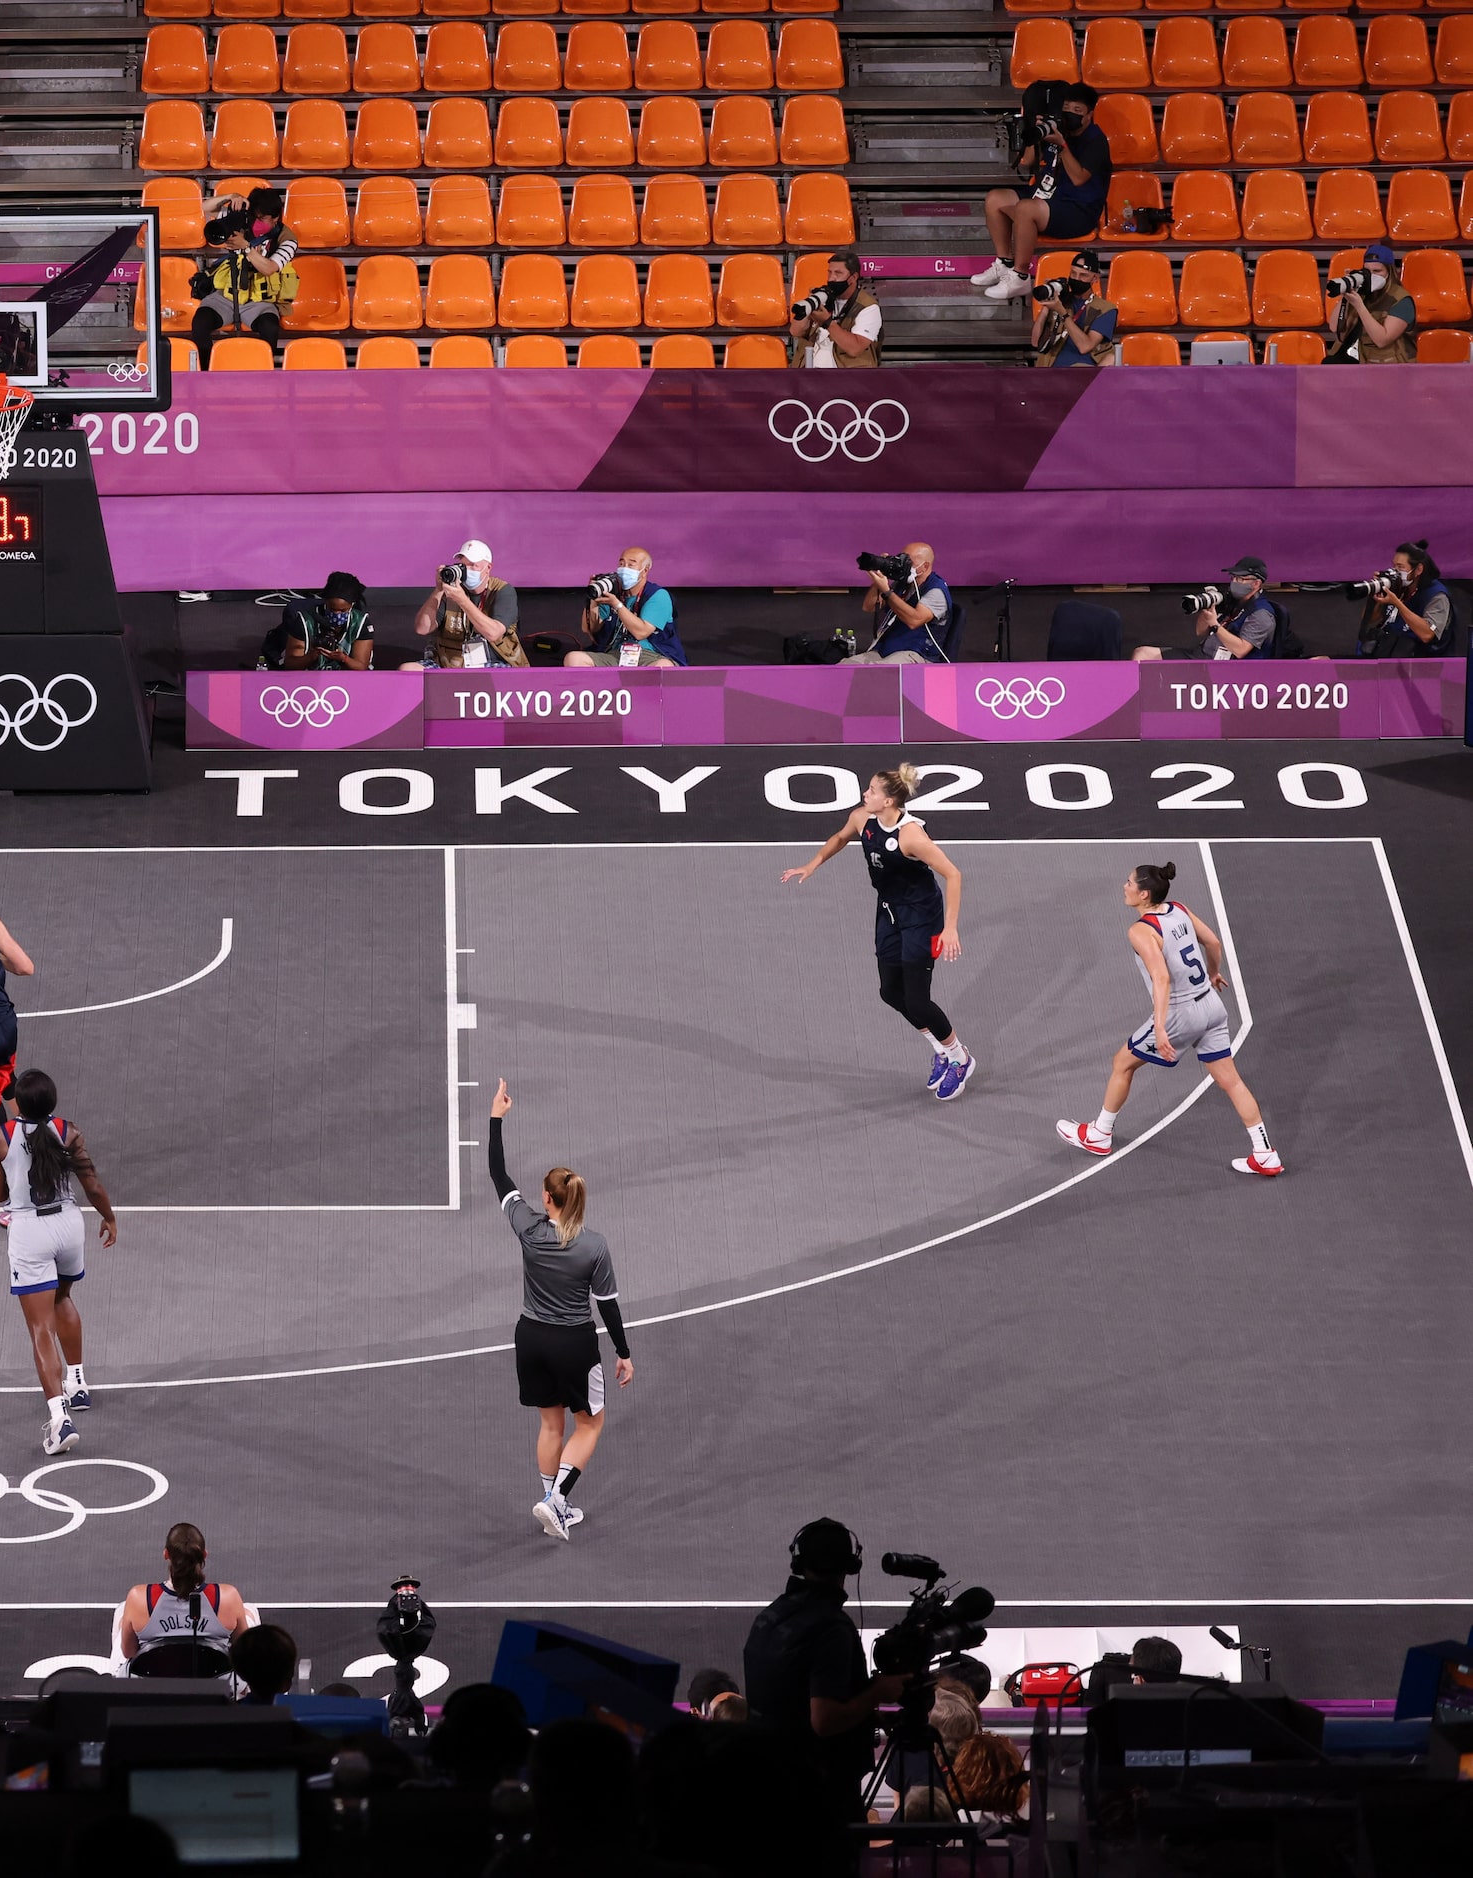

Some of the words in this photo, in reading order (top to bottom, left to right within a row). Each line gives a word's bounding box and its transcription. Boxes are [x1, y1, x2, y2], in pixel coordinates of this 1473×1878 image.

[45, 266, 55, 279] C
[935, 260, 943, 272] C
[79, 412, 199, 455] 2020
[23, 448, 77, 468] 2020
[453, 689, 552, 719] TOKYO
[559, 689, 632, 717] 2020
[1170, 683, 1269, 711] TOKYO
[1276, 683, 1349, 710] 2020
[870, 851, 884, 869] 15
[1179, 943, 1207, 986] 5
